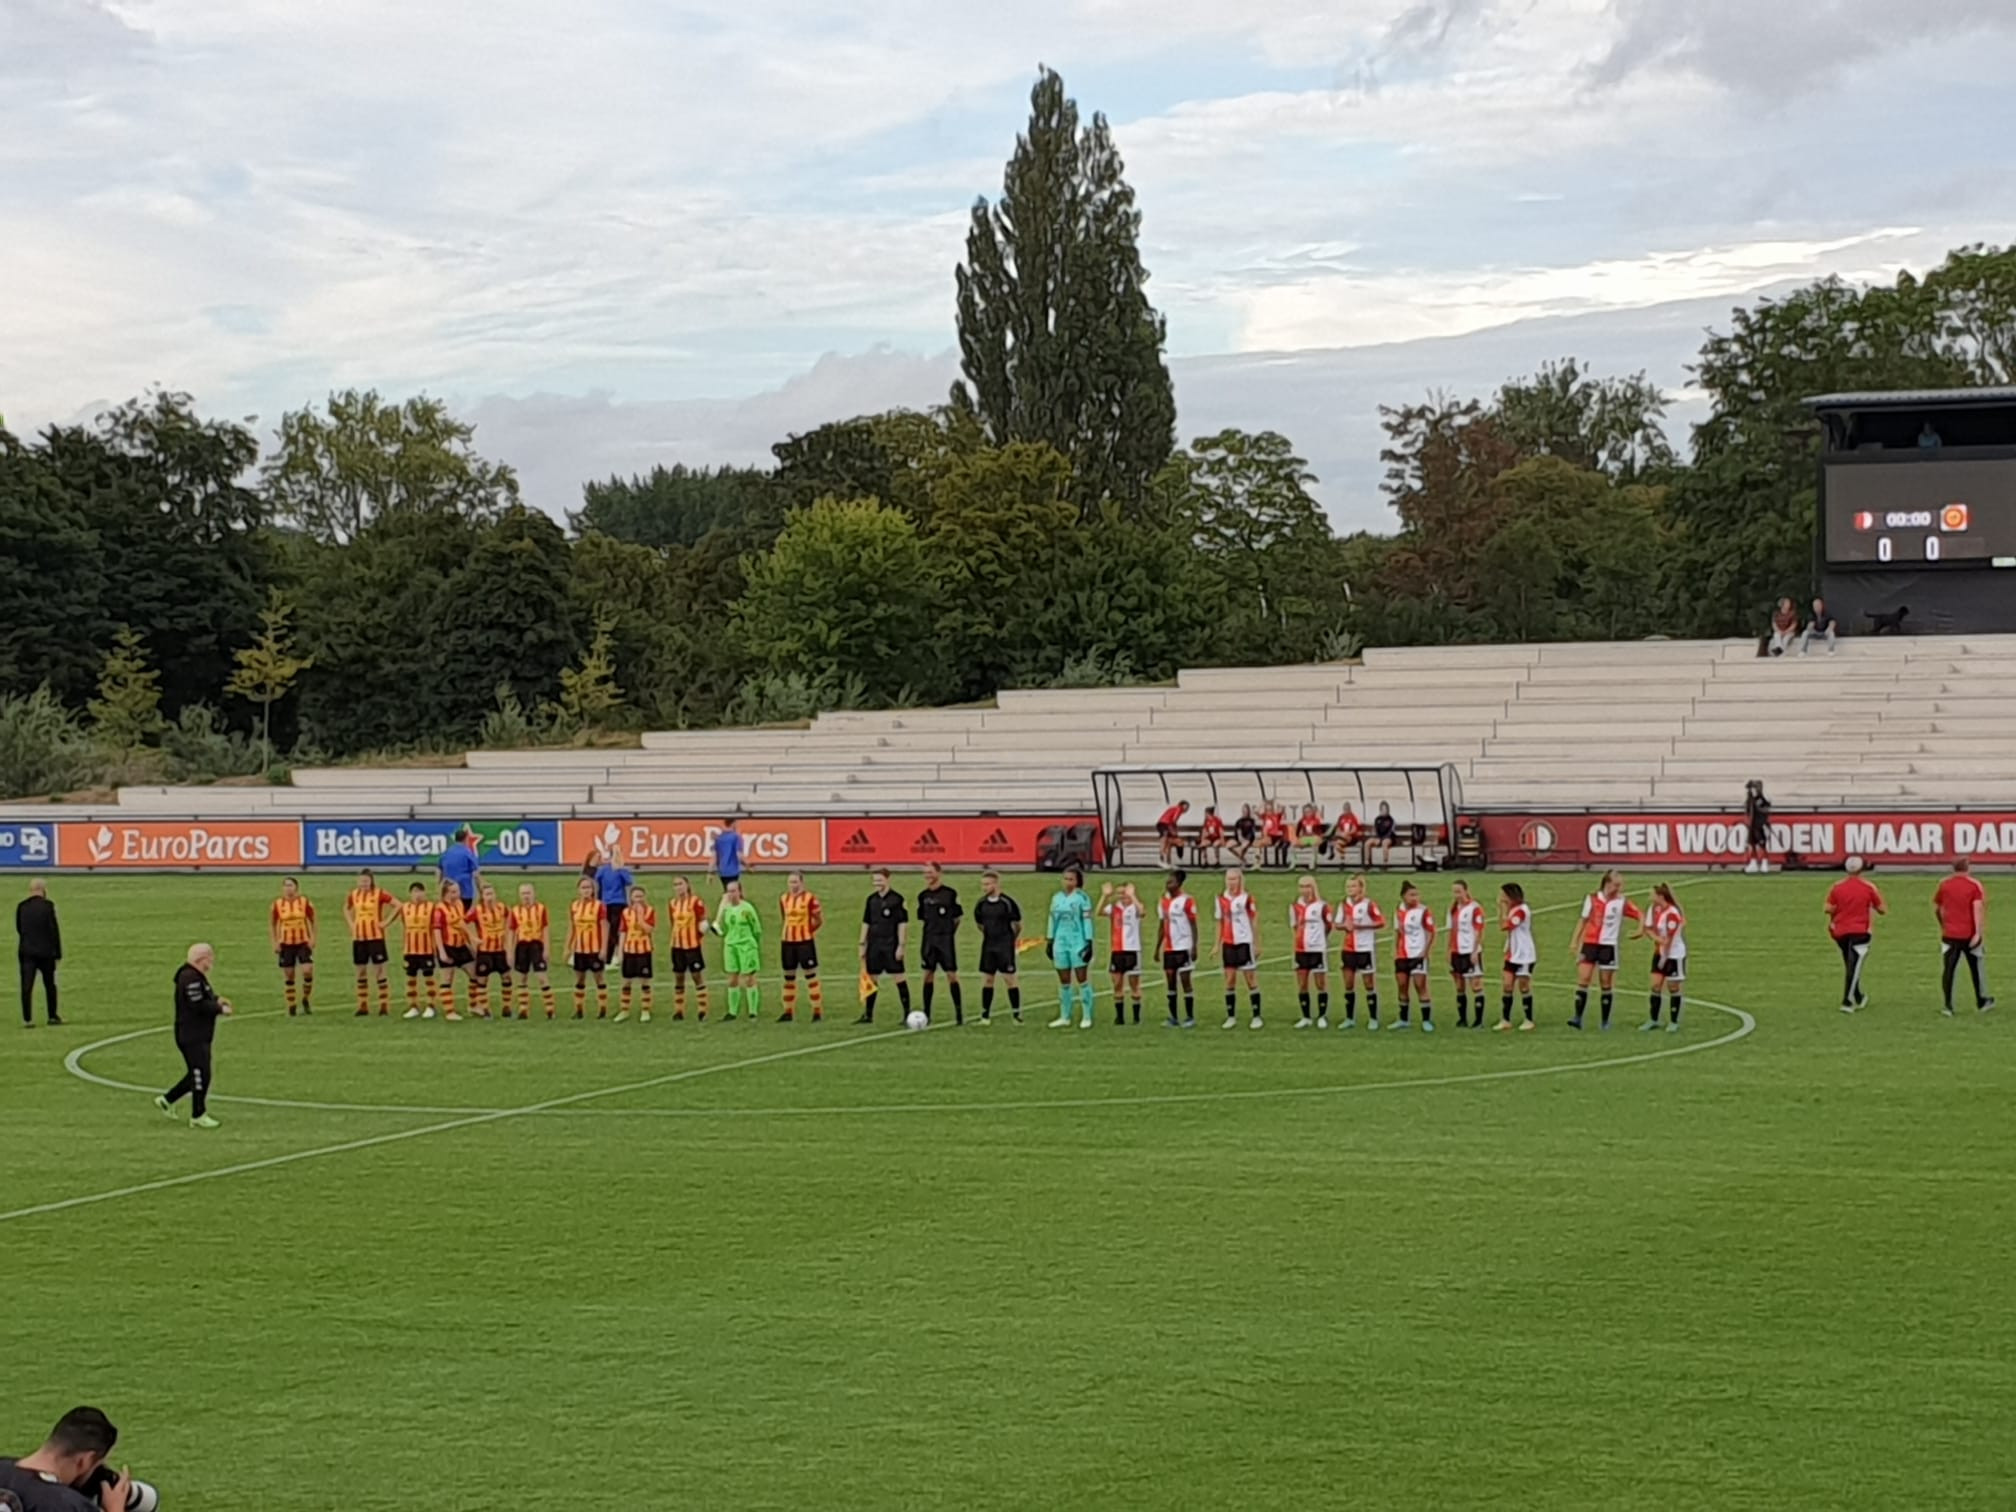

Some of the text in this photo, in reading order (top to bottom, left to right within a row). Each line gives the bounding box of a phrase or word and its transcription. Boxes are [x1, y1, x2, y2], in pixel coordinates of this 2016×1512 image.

[1878, 536, 1940, 562] 0 0
[121, 829, 269, 860] EuroParcs
[316, 828, 448, 856] Heineken
[629, 826, 789, 858] EuroPrcs
[1587, 823, 1669, 854] GEEN
[1676, 823, 1834, 854] WOODEN
[1844, 822, 1944, 854] MAAR
